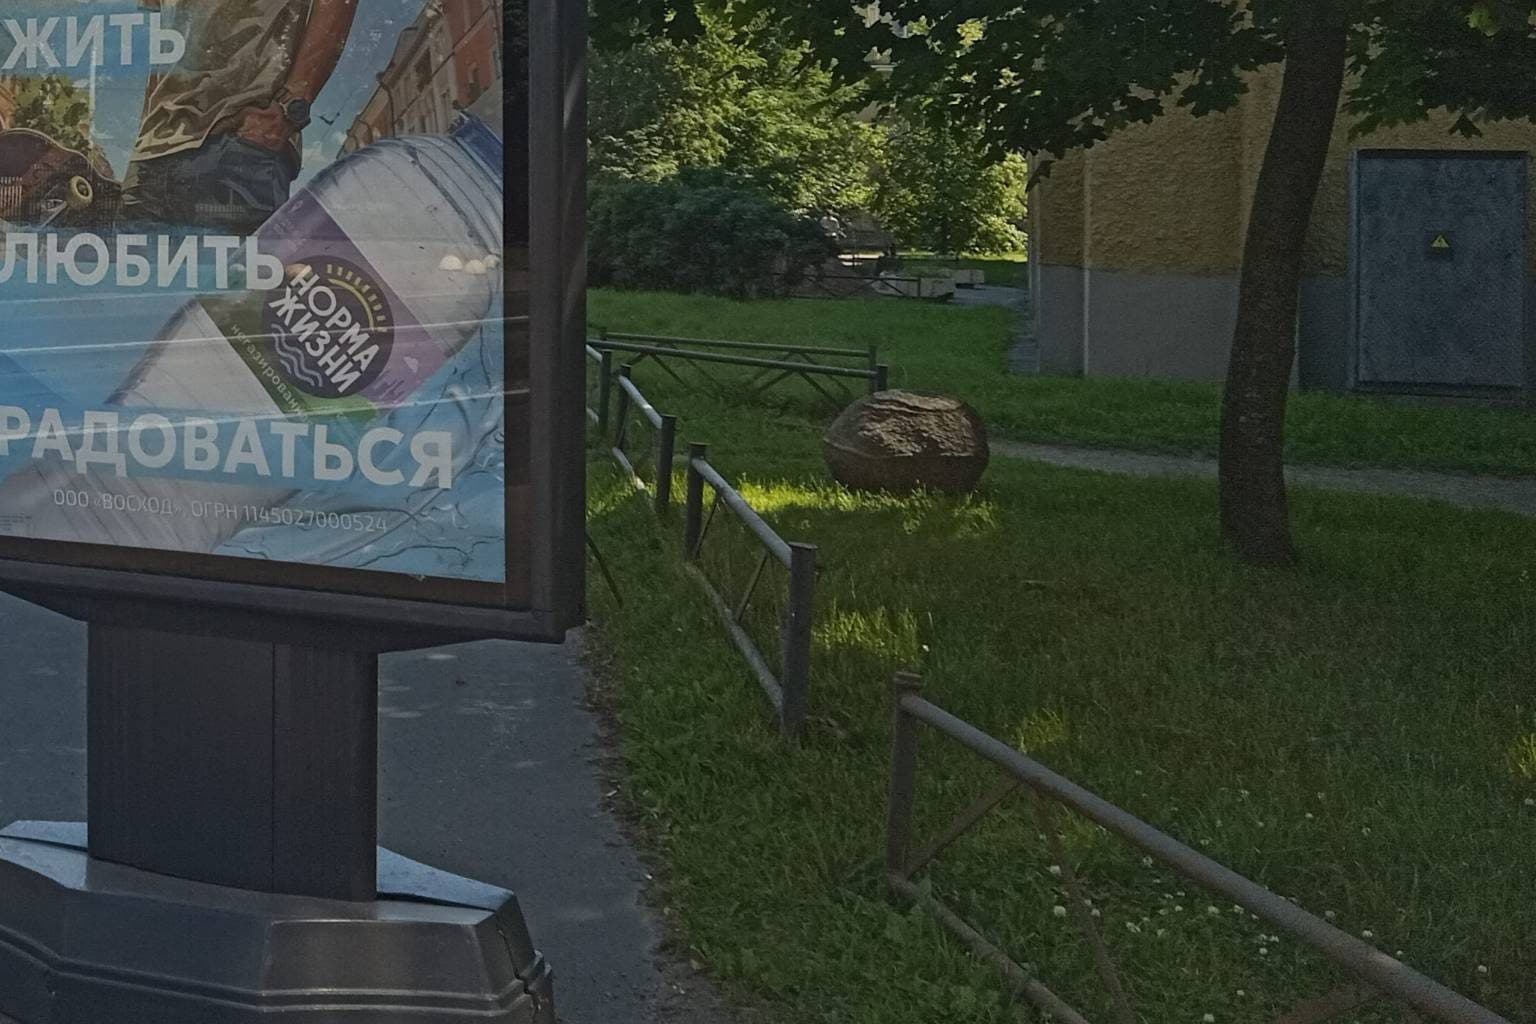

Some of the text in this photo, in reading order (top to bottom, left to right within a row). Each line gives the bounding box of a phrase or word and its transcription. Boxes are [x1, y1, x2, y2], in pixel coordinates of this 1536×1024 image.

[1, 12, 186, 70] ЖИТЬ
[268, 286, 362, 394] ЖИЗНИ
[290, 264, 380, 371] НОРМА
[53, 488, 89, 508] ООО
[191, 499, 238, 520] ОГРН
[243, 505, 387, 533] 1145027000524
